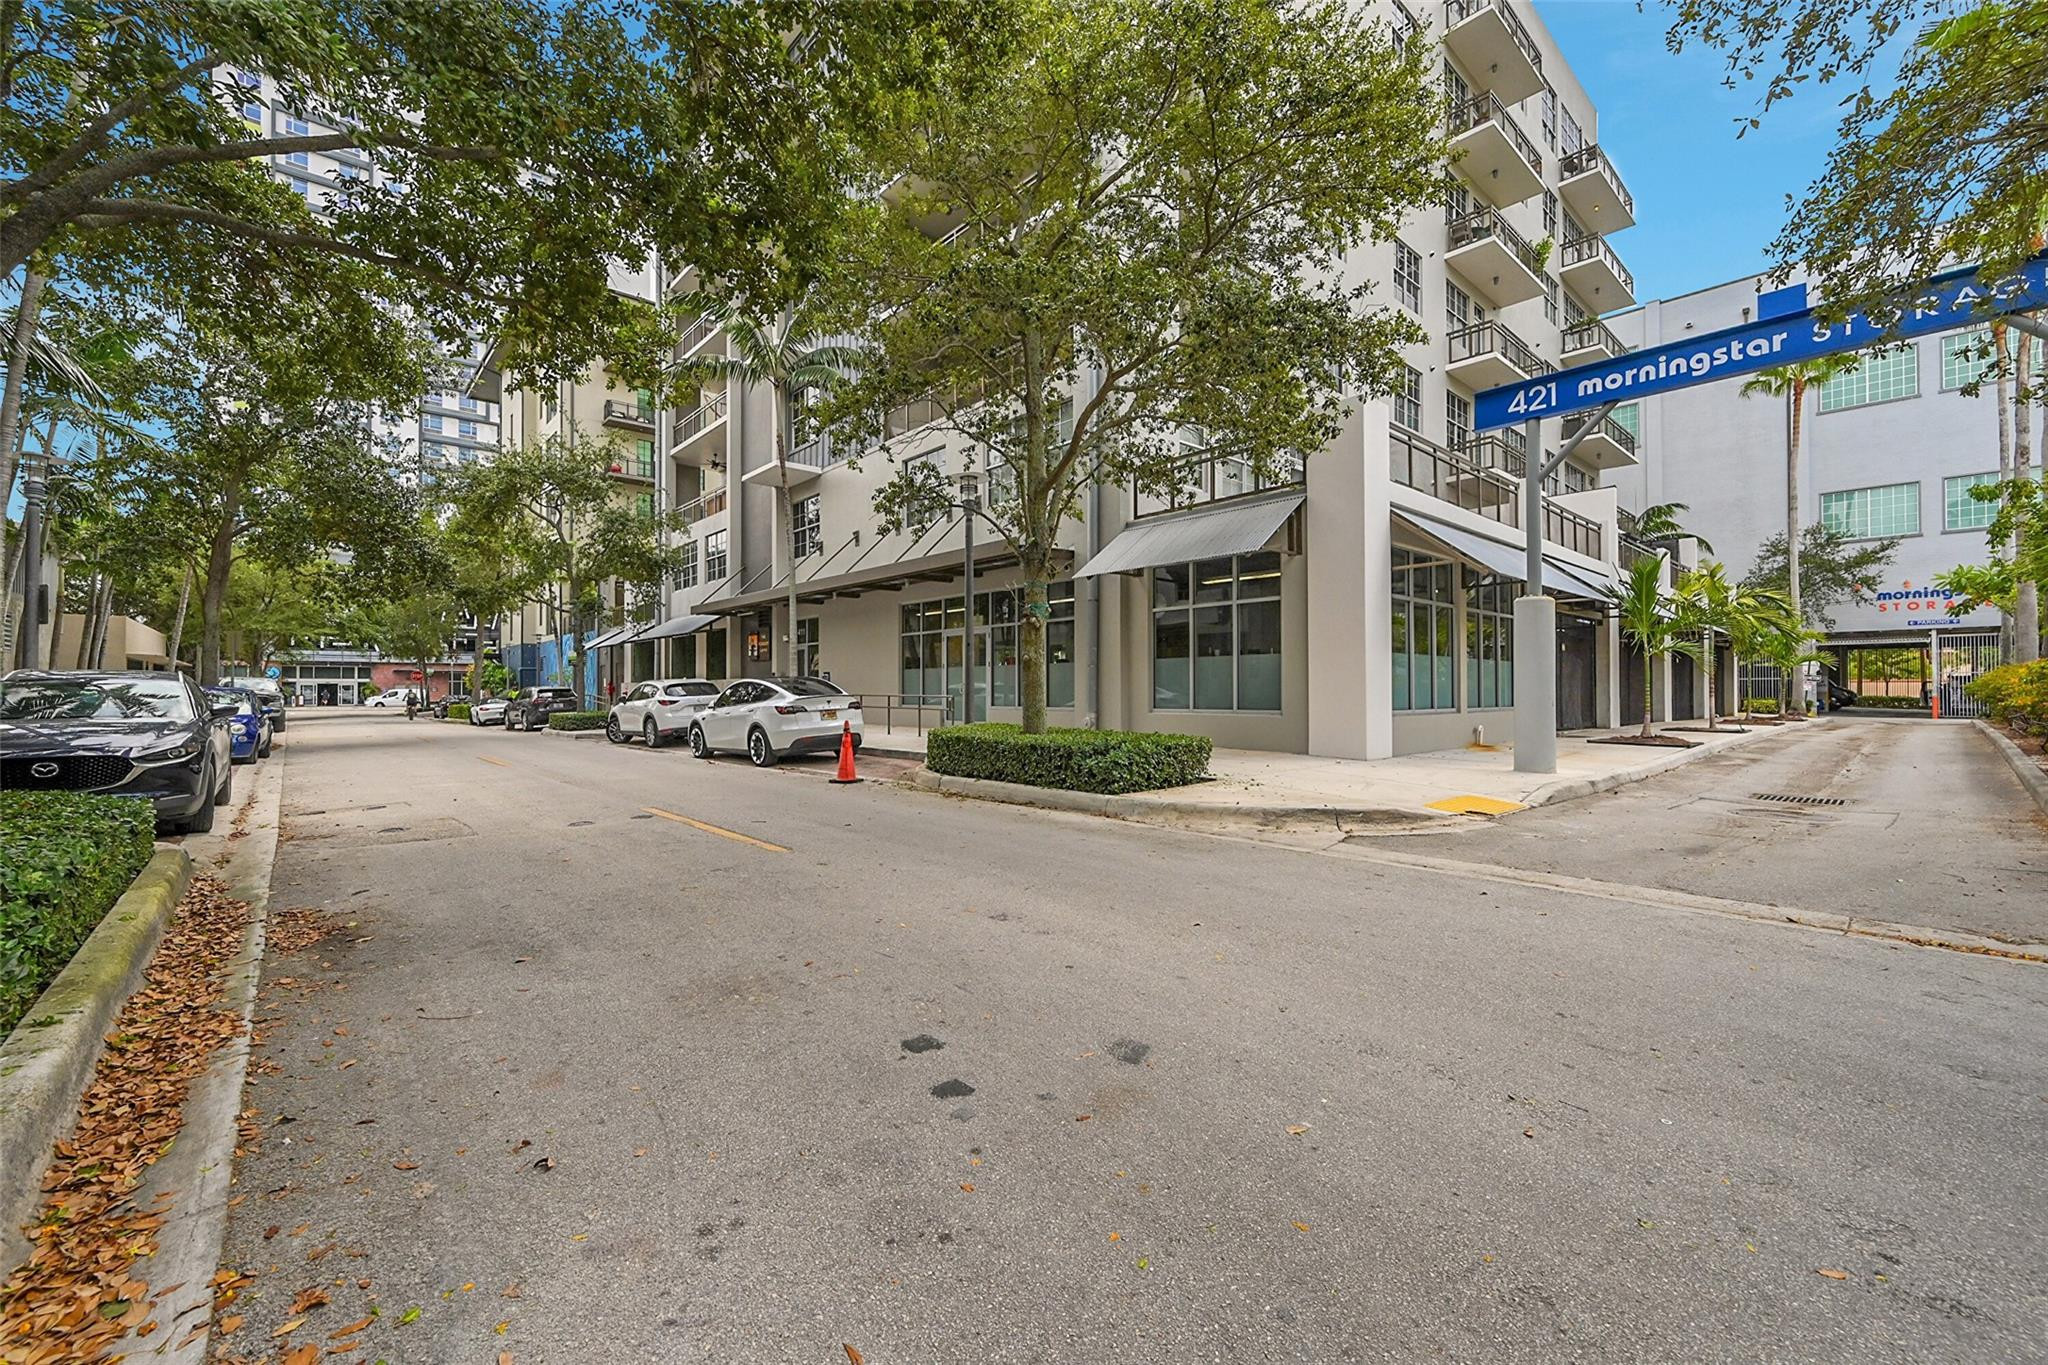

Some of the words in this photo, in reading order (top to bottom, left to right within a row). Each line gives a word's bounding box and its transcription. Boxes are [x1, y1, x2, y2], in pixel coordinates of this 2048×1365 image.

[1507, 382, 1557, 414] 421
[1577, 331, 1788, 397] morningstar
[1811, 267, 2048, 343] STORAG
[1877, 587, 1964, 600] morning
